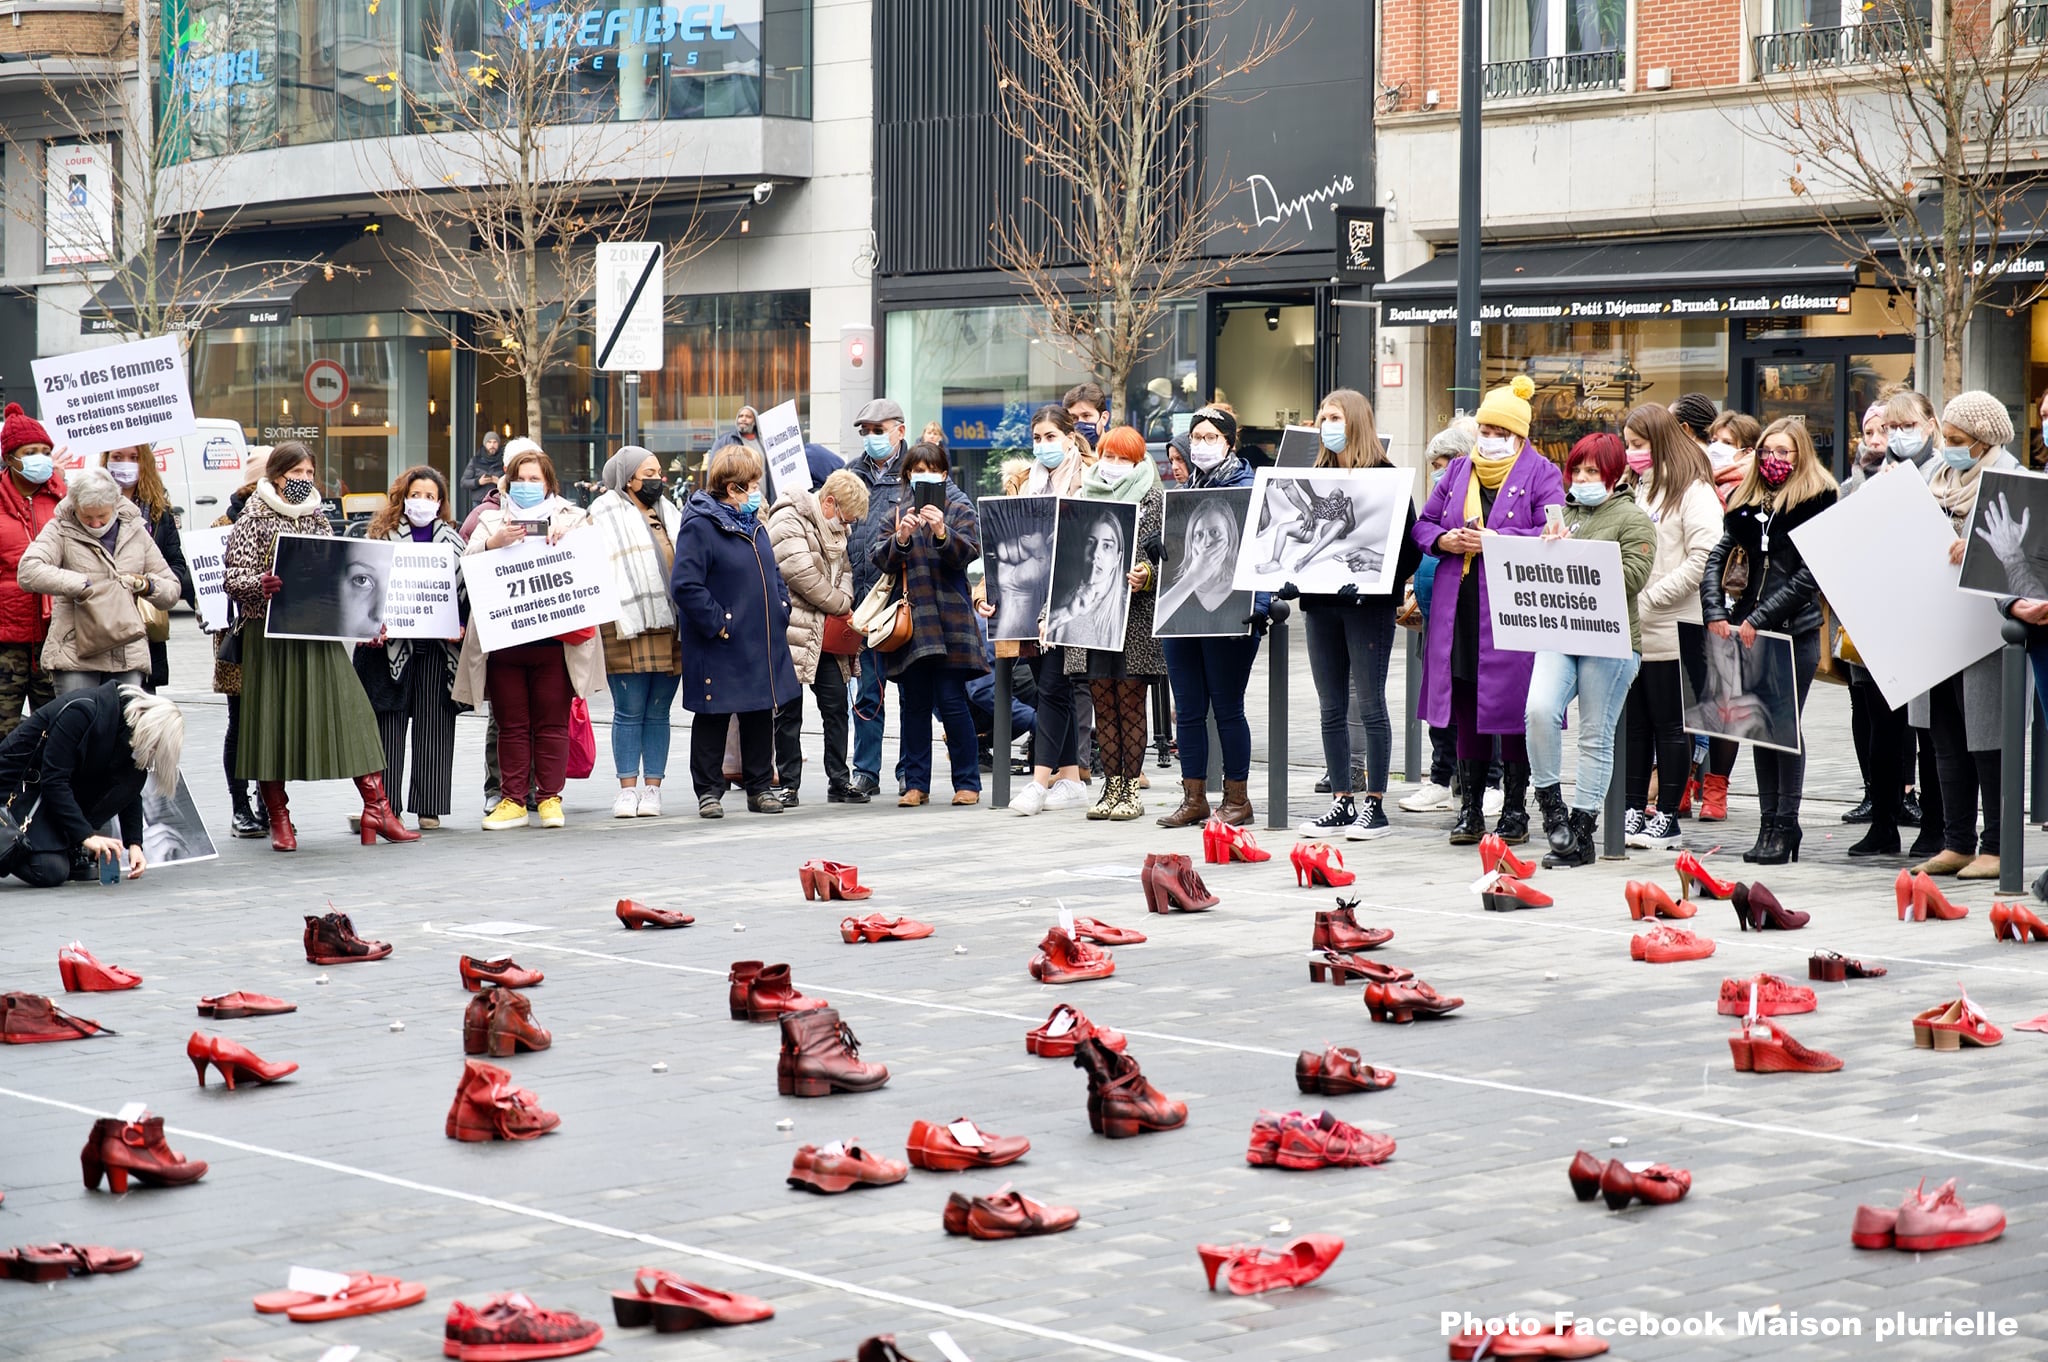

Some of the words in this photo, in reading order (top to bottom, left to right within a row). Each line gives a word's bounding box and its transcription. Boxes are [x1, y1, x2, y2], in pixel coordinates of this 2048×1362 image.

[519, 4, 737, 51] CREFIBEL
[65, 157, 93, 166] LOUER
[609, 249, 649, 262] ZONE
[249, 313, 259, 322] Bar
[260, 312, 264, 322] &
[264, 312, 278, 322] Food
[1503, 302, 1562, 318] Commune
[1570, 301, 1603, 316] Petit
[1605, 298, 1662, 317] Déjeuner
[1671, 298, 1720, 313] Brunch
[1728, 296, 1771, 311] Lunch
[1780, 294, 1839, 310] Gâteaux
[44, 372, 78, 393] 25%
[80, 369, 109, 387] des
[110, 356, 175, 380] femmes
[66, 397, 80, 408] se
[81, 389, 115, 405] voient
[116, 381, 160, 398] imposer
[55, 413, 76, 426] des
[77, 404, 125, 422] relations
[127, 393, 178, 411] sexuelles
[66, 423, 109, 439] forcées
[110, 420, 124, 431] en
[125, 410, 173, 428] Belgique
[205, 459, 239, 468] LUXAUTO
[192, 554, 220, 571] plus
[392, 555, 448, 569] emmes
[495, 559, 535, 577] Chaque
[536, 550, 576, 568] minute,
[1503, 561, 1513, 581] 1
[1514, 563, 1564, 584] petite
[1566, 564, 1601, 586] fille
[390, 579, 403, 589] de
[405, 579, 451, 590] handicap
[506, 579, 526, 599] 27
[528, 570, 575, 594] filles
[396, 591, 405, 601] la
[406, 591, 449, 602] violence
[489, 605, 513, 620] sont
[514, 595, 557, 615] mariées
[558, 592, 572, 603] de
[572, 585, 601, 600] force
[1514, 590, 1538, 607] est
[1540, 591, 1598, 611] excisée
[423, 604, 434, 615] et
[510, 616, 537, 630] dans
[538, 613, 549, 624] le
[550, 603, 586, 621] monde
[1498, 611, 1537, 628] toutes
[1539, 613, 1558, 629] les
[1560, 615, 1568, 630] 4
[1570, 616, 1621, 634] minutes
